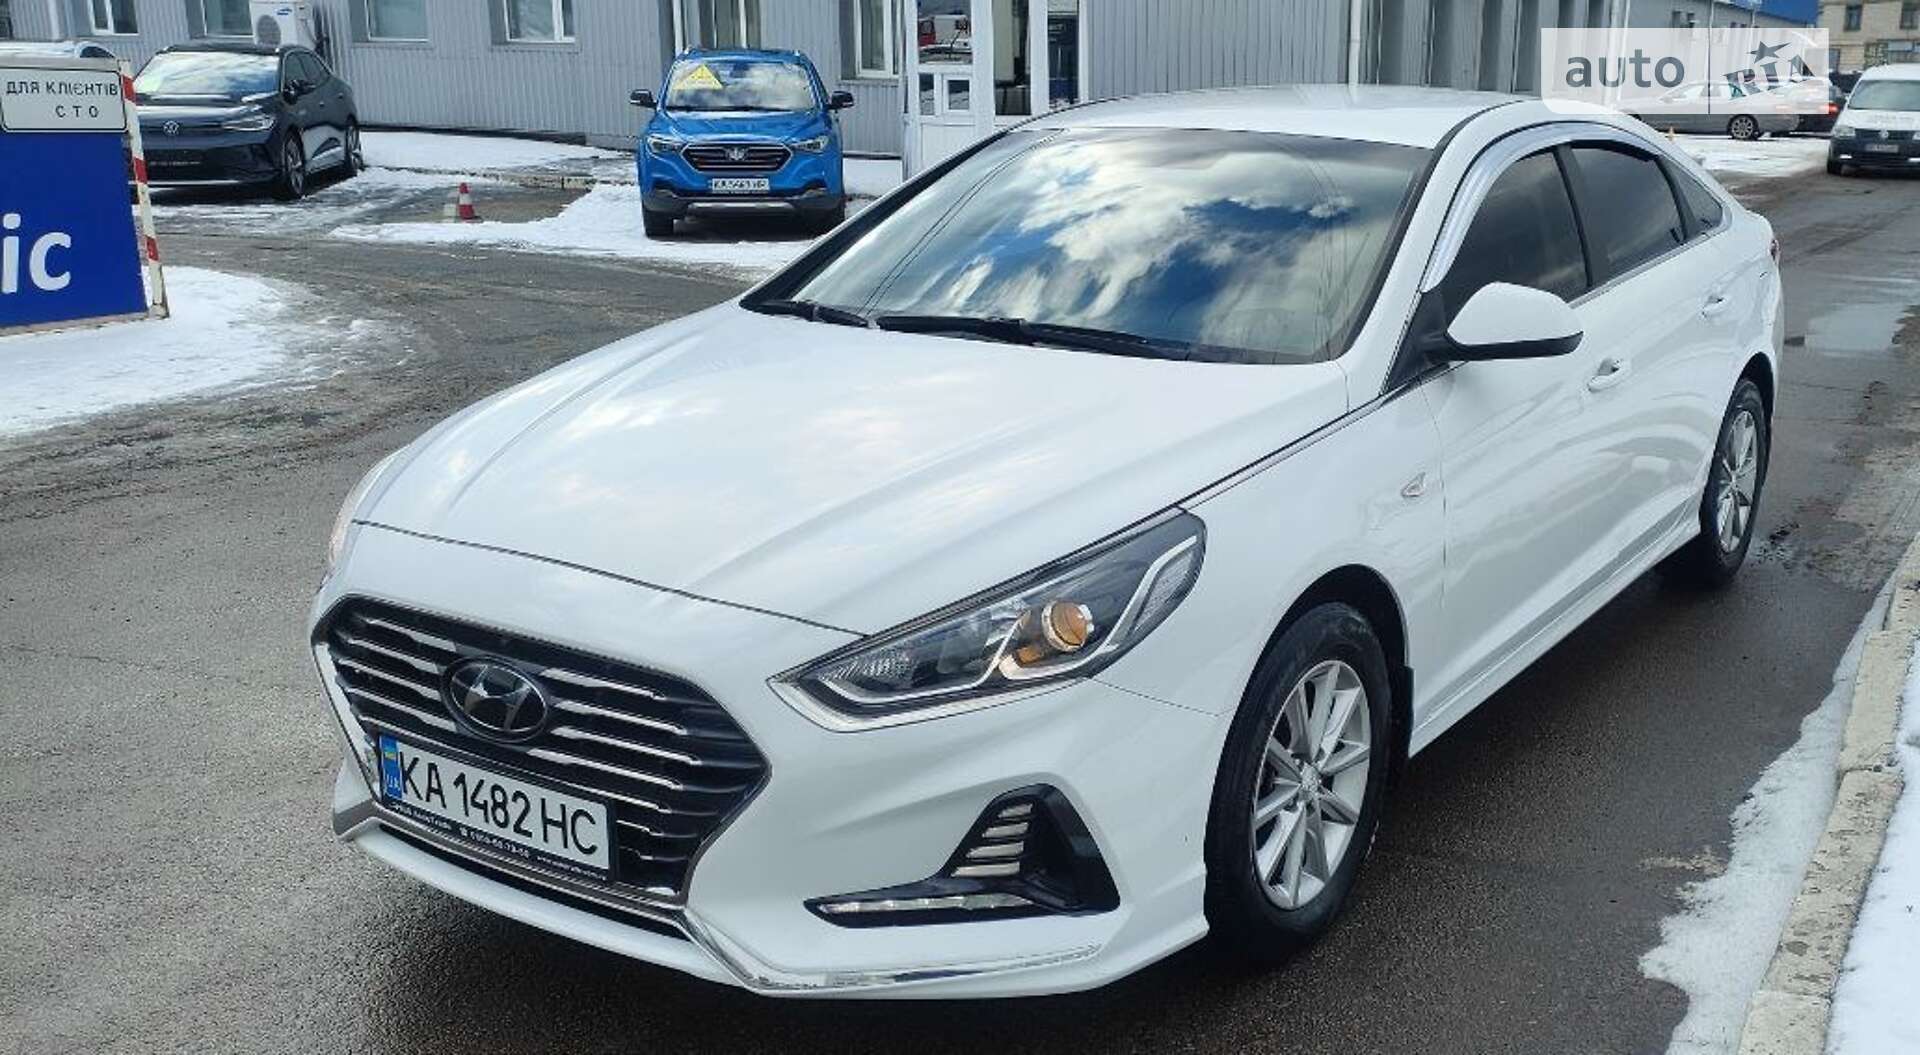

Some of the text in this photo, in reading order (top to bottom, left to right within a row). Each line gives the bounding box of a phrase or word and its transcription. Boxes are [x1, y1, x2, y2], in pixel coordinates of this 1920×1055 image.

[6, 81, 119, 96] ДЛЯ КЛІЄНТІВ
[453, 772, 533, 838] 1482
[541, 797, 598, 855] HC
